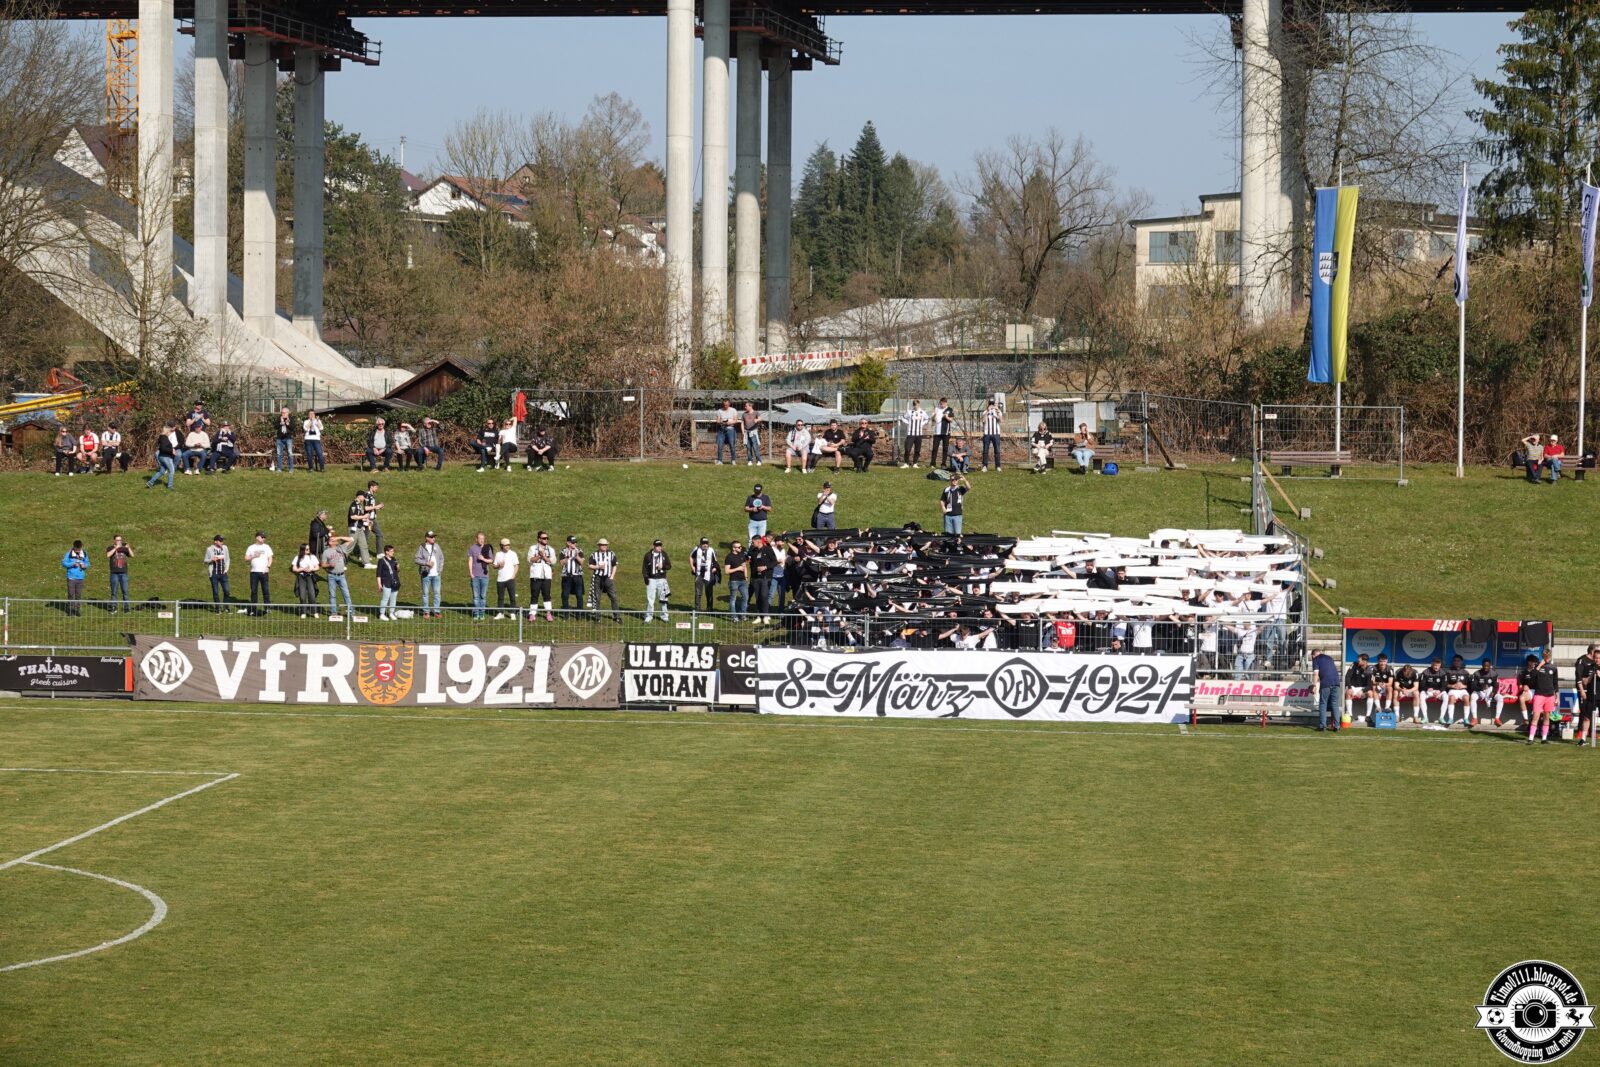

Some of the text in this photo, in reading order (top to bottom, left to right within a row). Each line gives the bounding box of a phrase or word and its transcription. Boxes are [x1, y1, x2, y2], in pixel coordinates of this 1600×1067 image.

[1433, 620, 1462, 631] GAST
[18, 660, 90, 678] THALASSA
[628, 645, 714, 669] ULTRAS
[198, 640, 554, 703] VfR 1921
[634, 673, 707, 698] VORAN
[776, 658, 975, 717] 8. März
[1059, 664, 1185, 715] 1921
